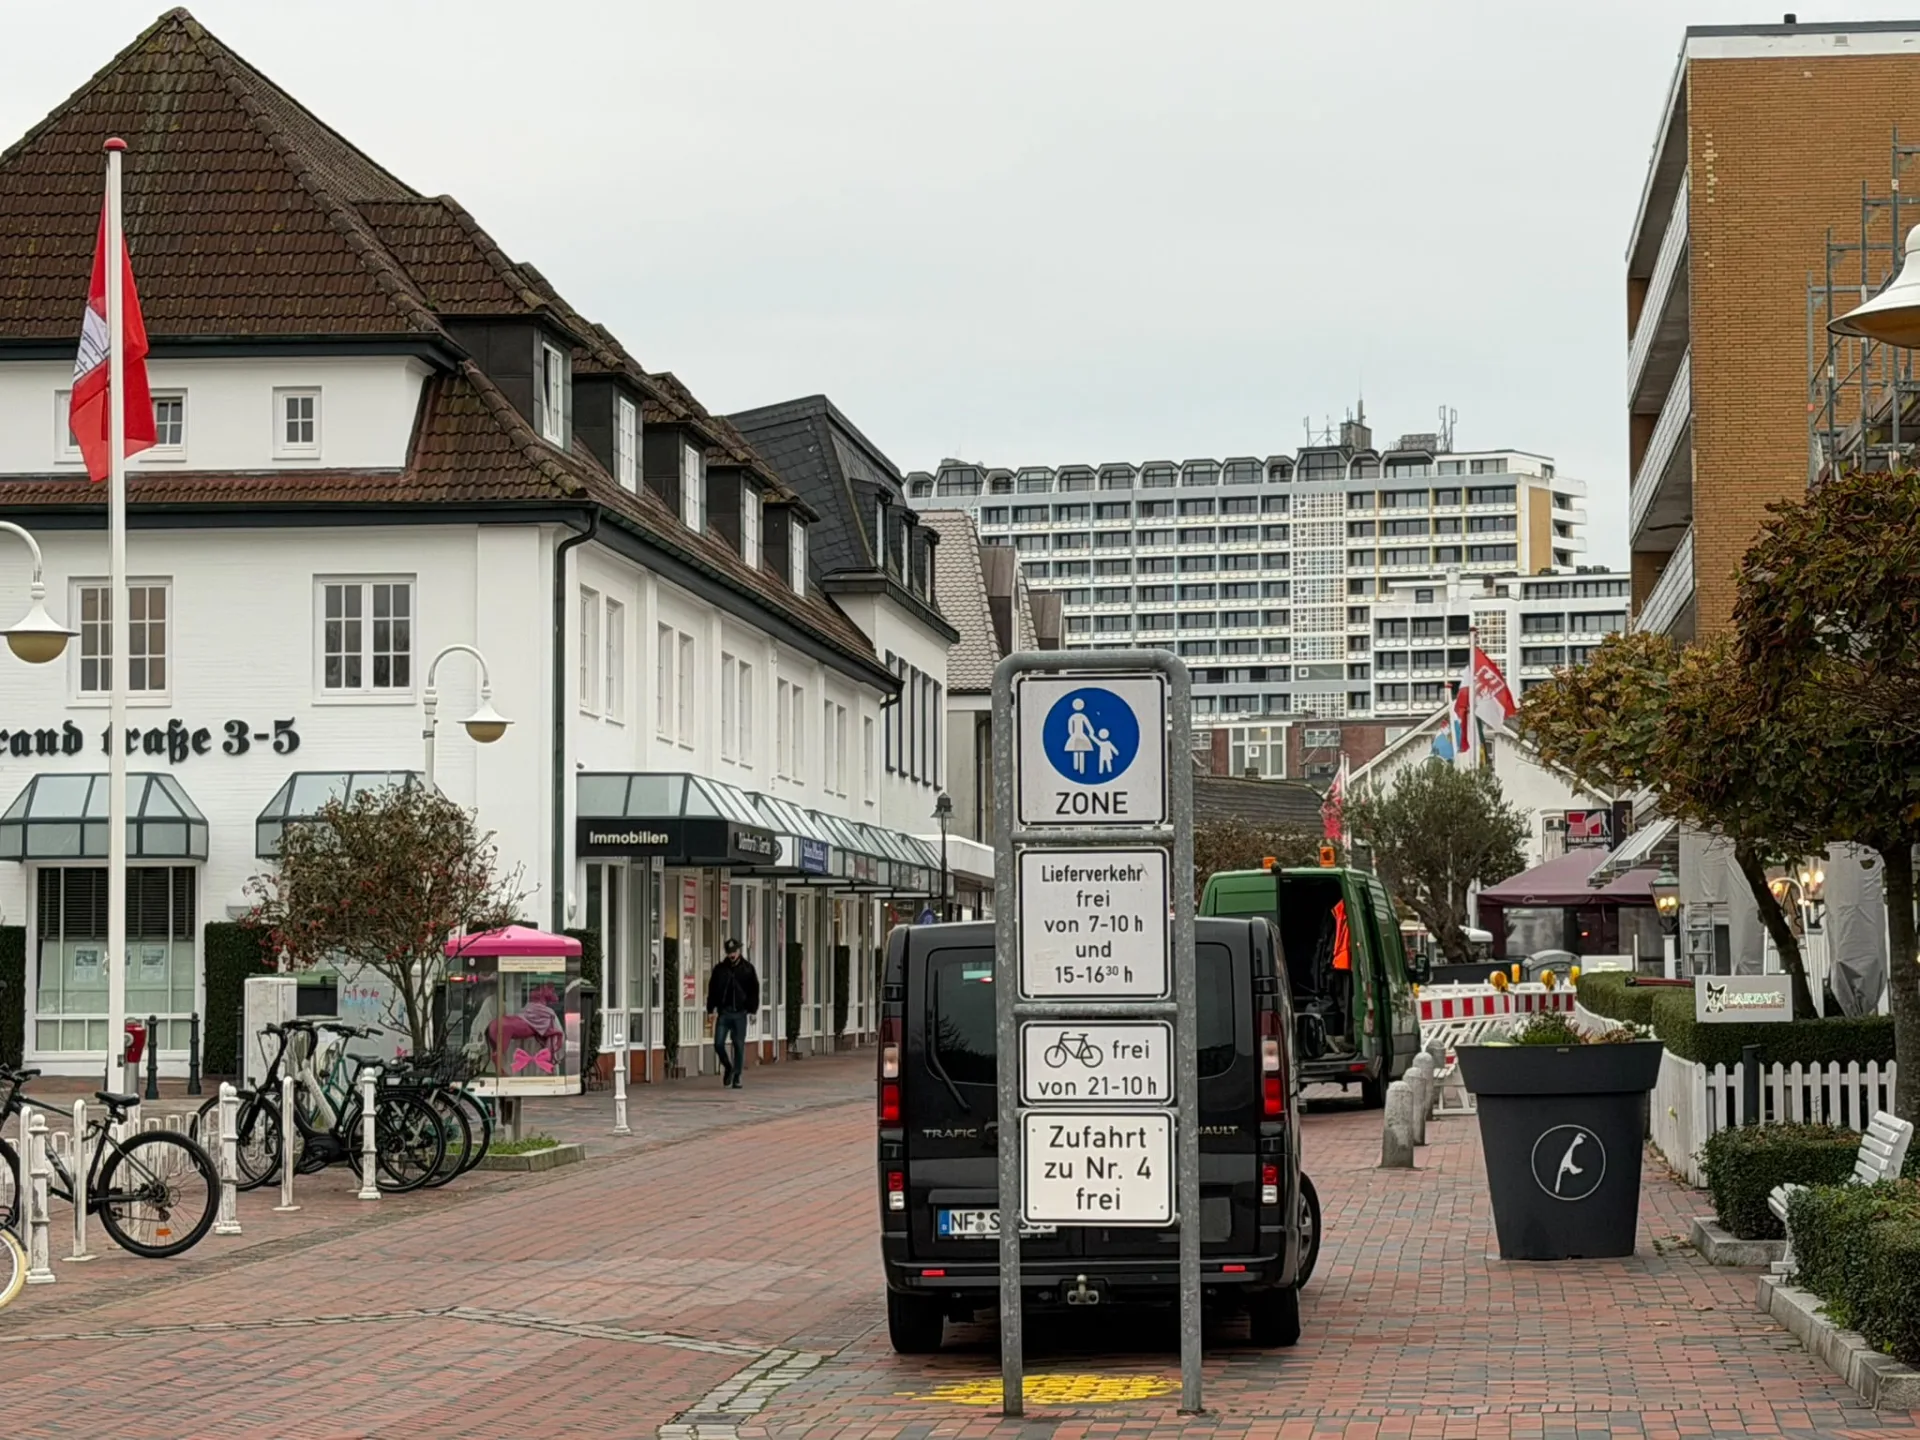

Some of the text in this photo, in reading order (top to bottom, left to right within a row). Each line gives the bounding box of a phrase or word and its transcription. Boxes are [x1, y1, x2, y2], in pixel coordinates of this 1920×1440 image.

[222, 716, 301, 756] 3-5
[1055, 791, 1128, 815] ZONE
[589, 831, 669, 845] Immobilien
[1041, 863, 1143, 883] Lieferverkehr
[1076, 889, 1110, 908] frei
[1044, 914, 1143, 933] von 7-10 h
[1075, 940, 1112, 958] und
[1124, 965, 1133, 983] h
[1112, 1039, 1150, 1059] frei
[1037, 1075, 1157, 1096] von 21-10 h
[922, 1128, 977, 1138] TRAFIC
[1049, 1125, 1147, 1149] Zufahrt
[1198, 1126, 1239, 1135] AULT
[1044, 1156, 1152, 1180] zu Nr. 4
[1076, 1187, 1121, 1211] frei
[951, 1212, 975, 1231] NF
